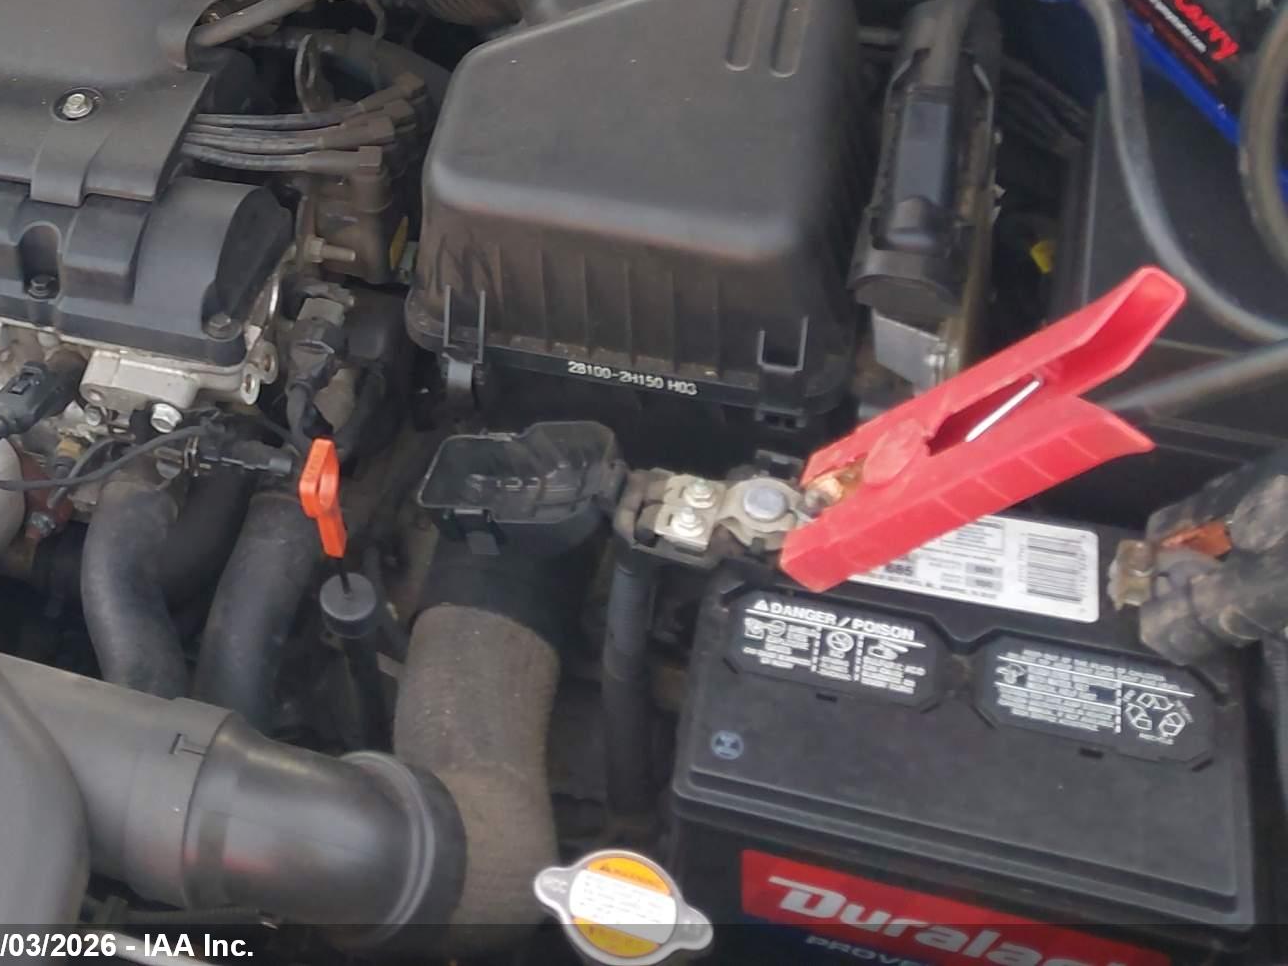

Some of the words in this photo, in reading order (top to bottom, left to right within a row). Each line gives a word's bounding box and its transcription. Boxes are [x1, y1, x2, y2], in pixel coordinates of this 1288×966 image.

[567, 360, 665, 390] 28100-2H150
[770, 602, 838, 626] DANGER
[851, 617, 916, 641] POISON
[767, 875, 1129, 966] Durala
